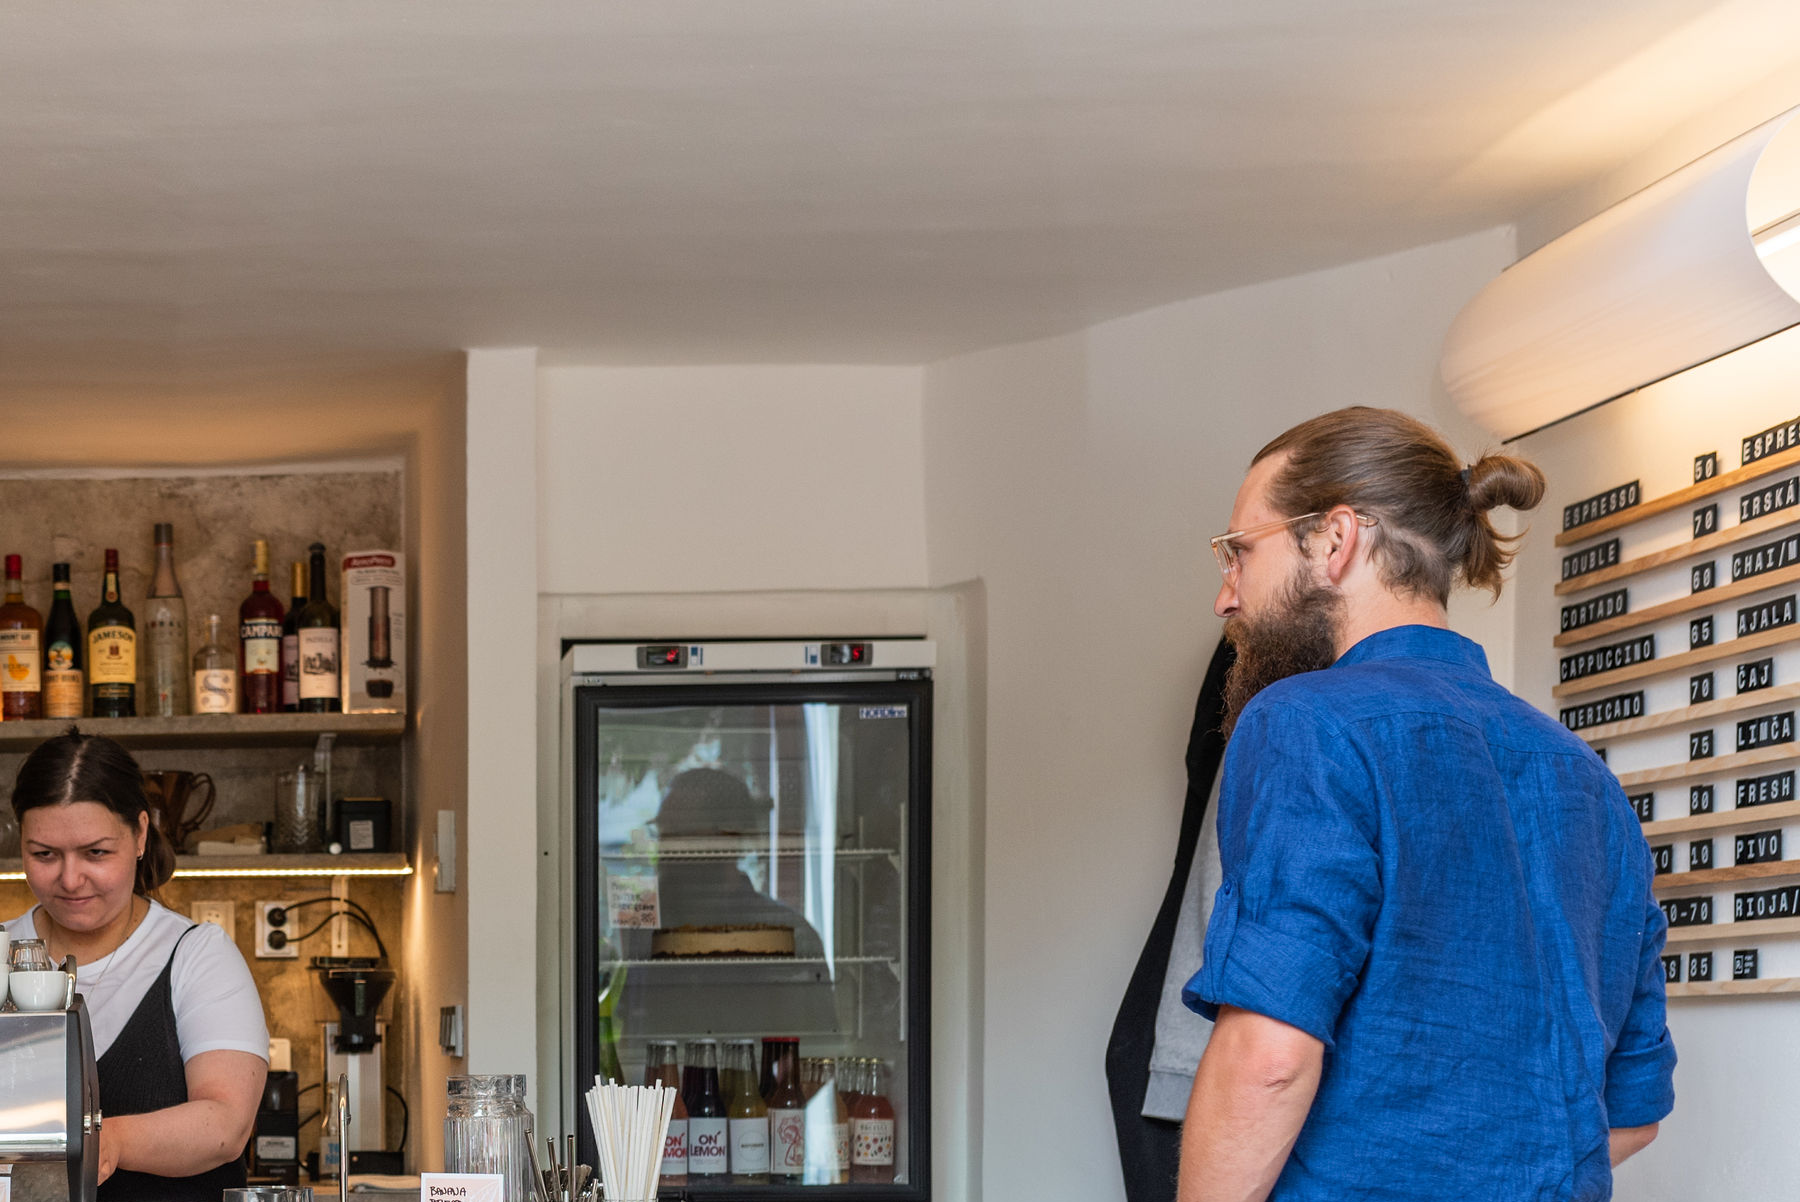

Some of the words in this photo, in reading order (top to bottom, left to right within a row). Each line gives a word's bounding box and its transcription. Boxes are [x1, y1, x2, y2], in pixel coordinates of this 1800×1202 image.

[1743, 422, 1800, 462] ESPRE
[1564, 485, 1637, 528] ESPRESSO
[1695, 457, 1714, 480] 50
[1741, 479, 1796, 521] IRSKÁ
[1563, 543, 1616, 578] DOUBLE
[1694, 509, 1714, 535] 70
[1561, 594, 1624, 629] CORTADO
[1692, 567, 1712, 590] 60
[1738, 601, 1792, 635] AJALA
[93, 632, 134, 644] JAMESON
[1561, 640, 1651, 679] CAPPUCCINO
[1691, 621, 1710, 643] 65
[1738, 664, 1769, 689] ČAJ
[1561, 695, 1641, 729] AMERICANO
[1691, 677, 1709, 700] 70
[1691, 732, 1709, 756] 75
[1737, 717, 1791, 747] LIMČA
[1691, 791, 1709, 810] 80
[1737, 775, 1790, 804] FRESH
[1691, 845, 1709, 865] 10
[1736, 835, 1778, 860] PIVO
[1690, 957, 1709, 977] 85
[690, 1144, 726, 1156] LEMON
[429, 1186, 467, 1197] BANANA
